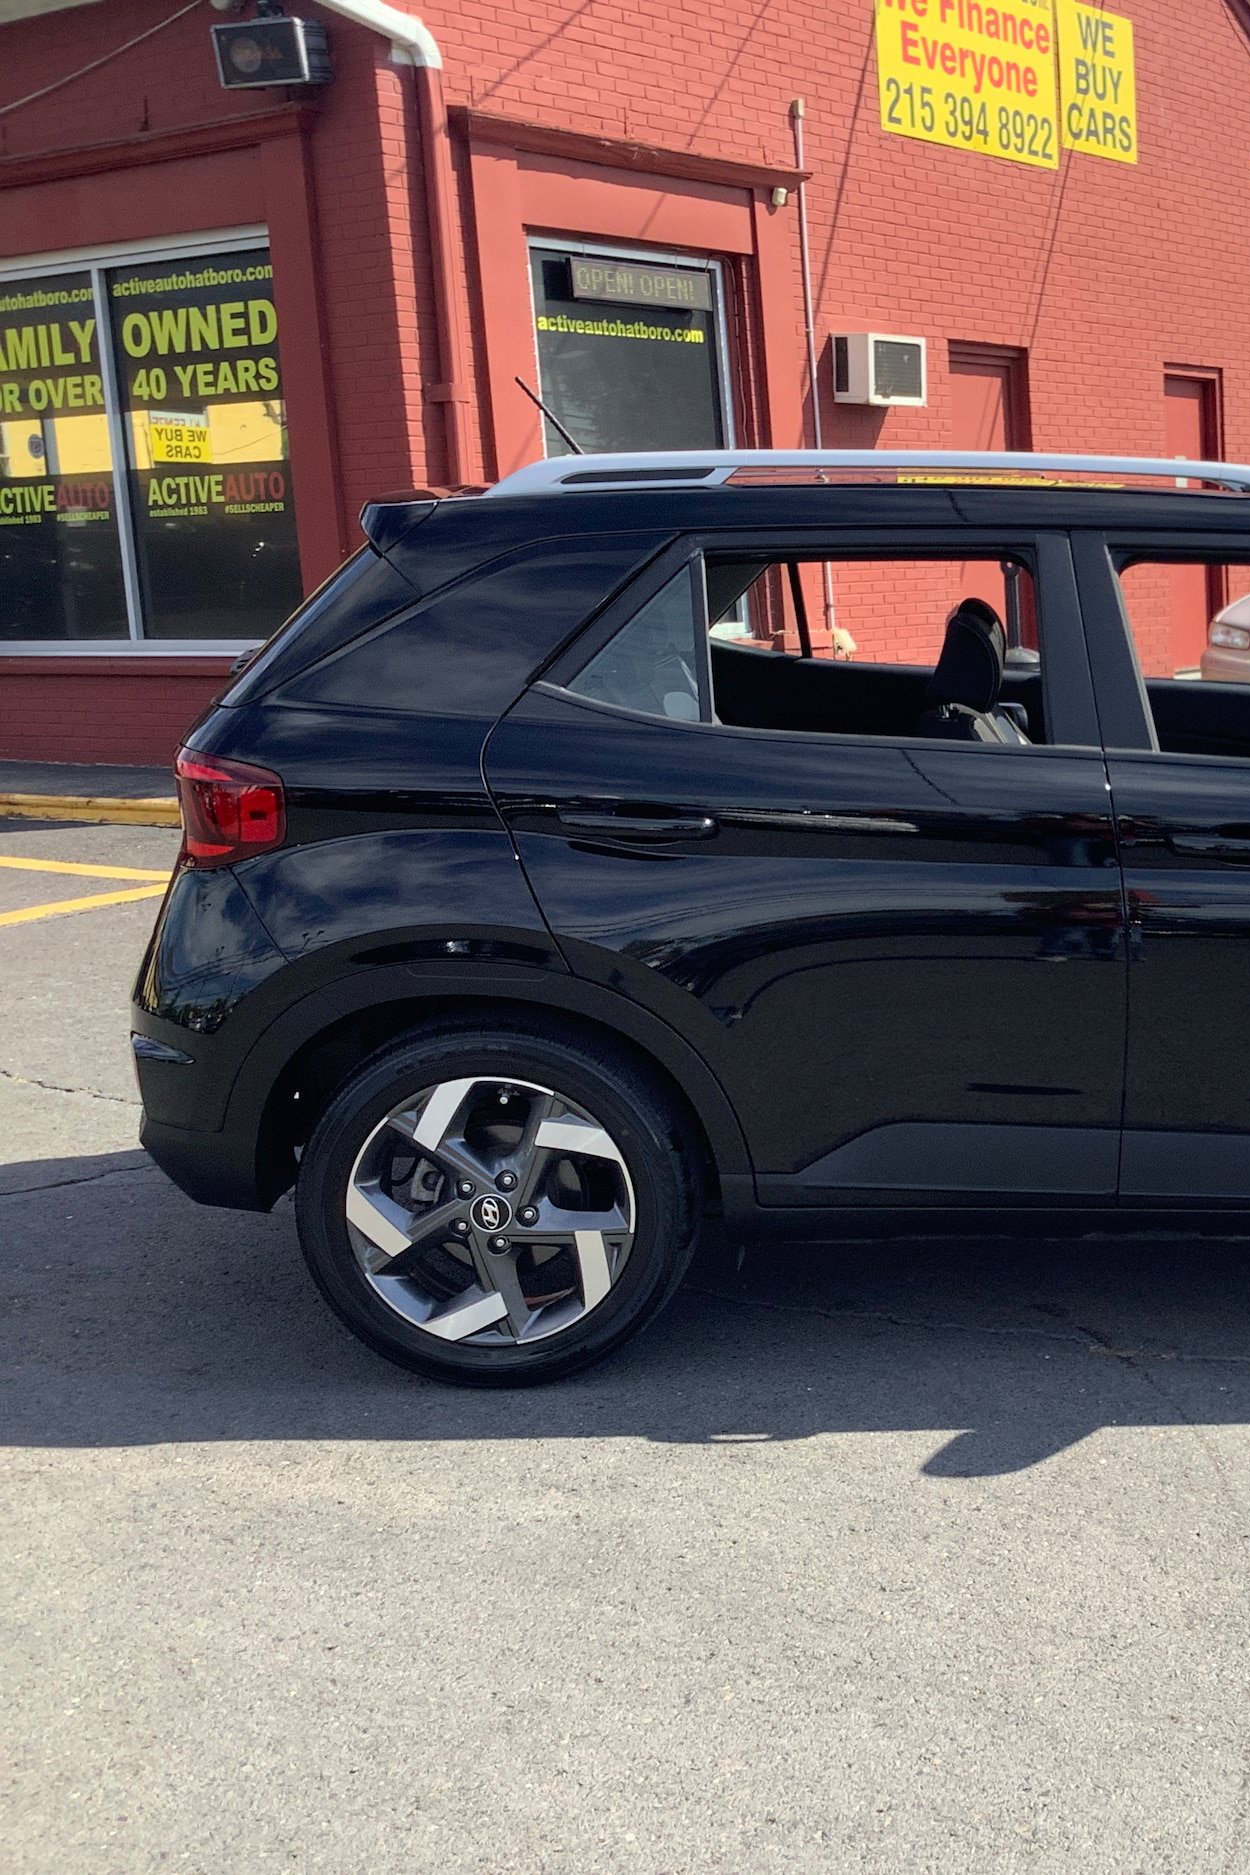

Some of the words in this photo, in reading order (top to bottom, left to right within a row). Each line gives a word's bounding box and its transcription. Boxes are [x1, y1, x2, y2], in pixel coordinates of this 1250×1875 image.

[900, 20, 1038, 97] Everyone
[1076, 12, 1116, 59] WE
[1075, 57, 1123, 104] BUY
[886, 77, 935, 133] 215
[944, 92, 989, 146] 394
[998, 106, 1053, 160] 8922
[1067, 102, 1132, 152] CARS
[576, 268, 634, 295] OPEN!
[640, 275, 694, 301] OPEN!
[122, 299, 278, 358] OWNED
[537, 315, 704, 344] activeautohatboro.com
[0, 382, 23, 413] R
[28, 374, 105, 411] OVER
[132, 368, 167, 400] 40
[174, 357, 279, 398] YEARS
